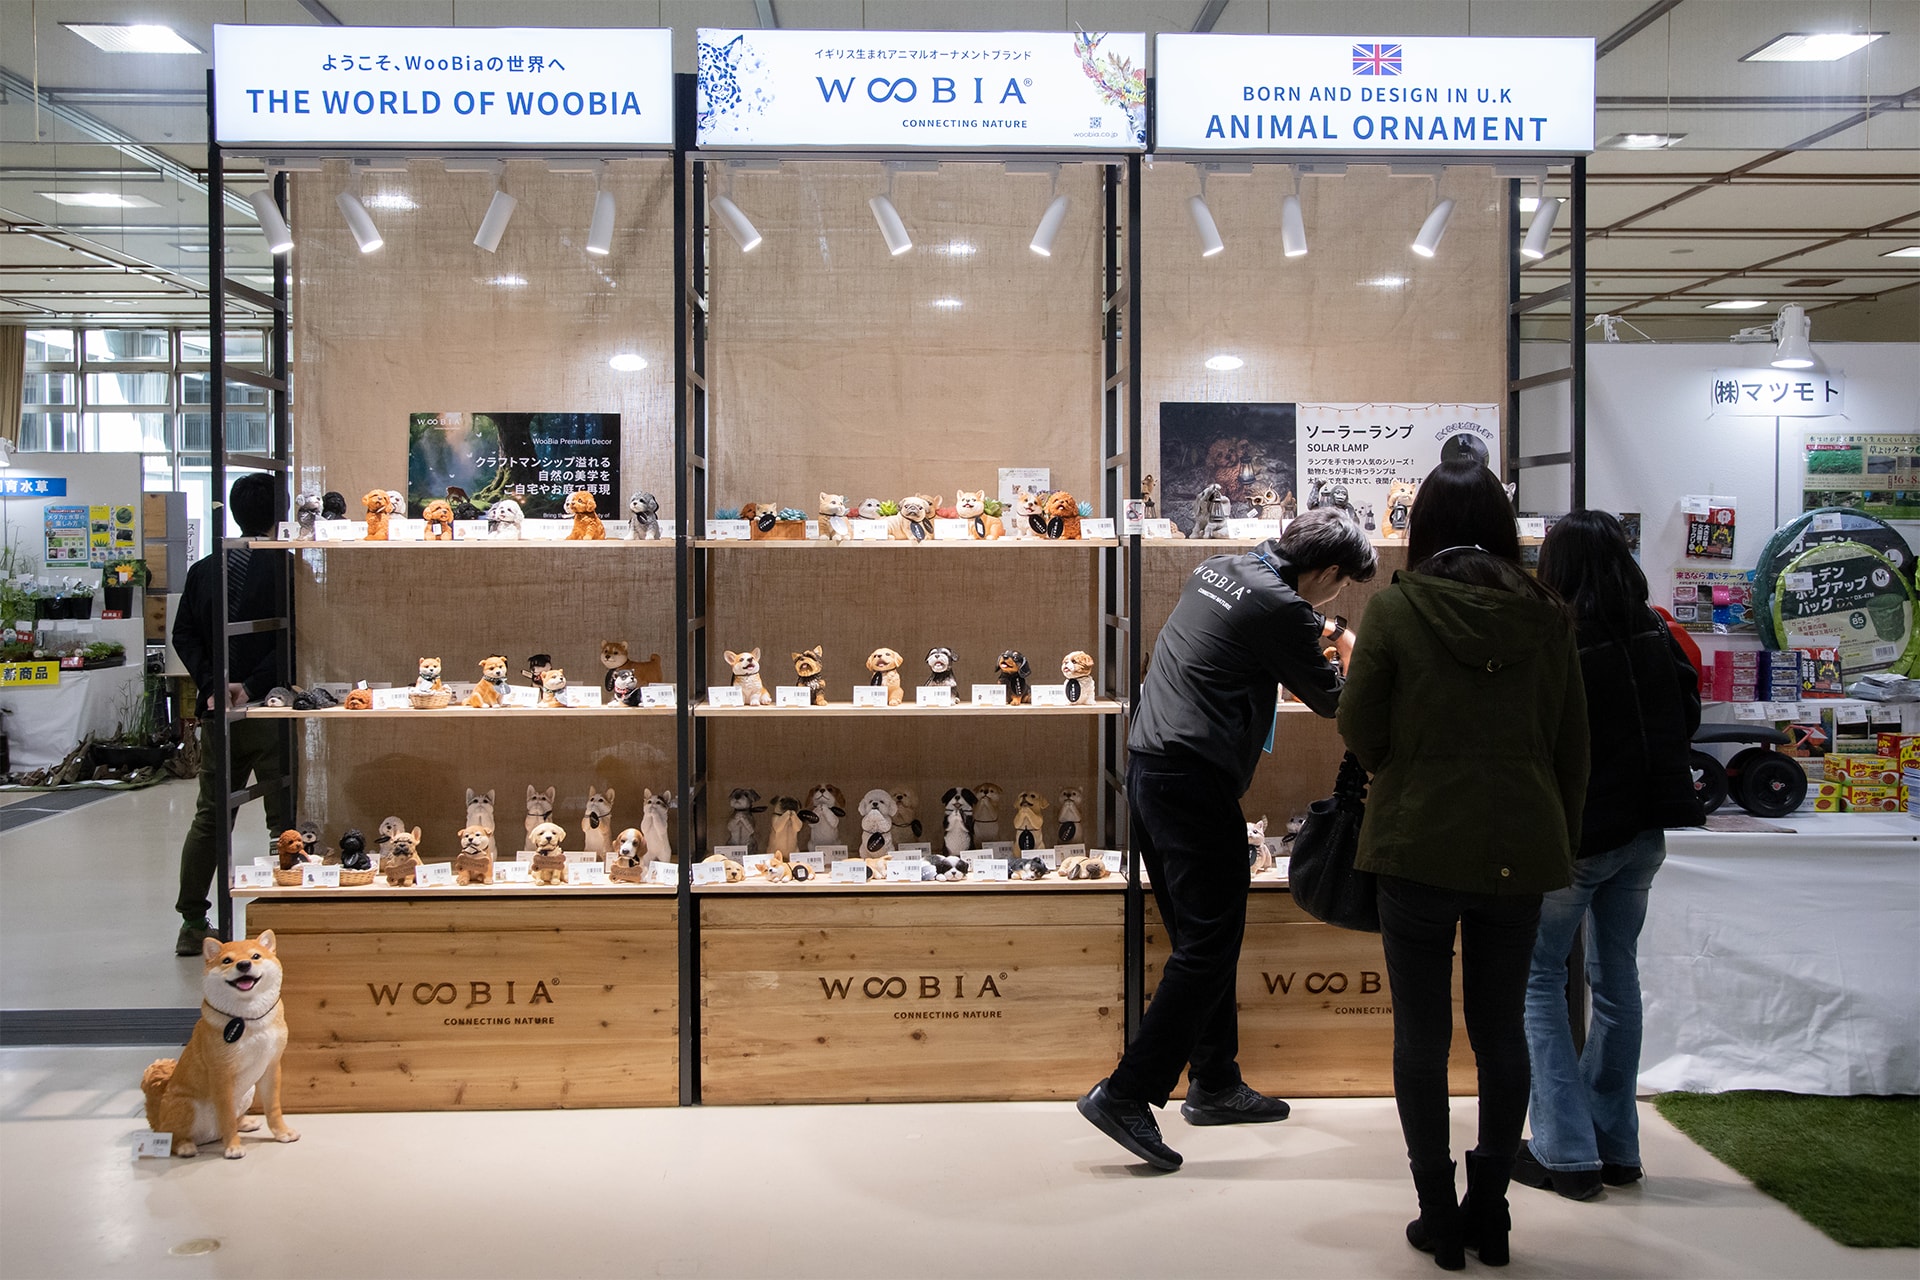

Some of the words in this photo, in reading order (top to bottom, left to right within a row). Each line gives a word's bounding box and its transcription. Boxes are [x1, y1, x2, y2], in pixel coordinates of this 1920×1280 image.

[814, 48, 1032, 61] イギリス生まれアニマルオーナメントブランド
[321, 54, 566, 73] ようこそ、WooBiaの世界へ
[1242, 86, 1301, 101] BORN
[1309, 86, 1351, 102] AND
[1360, 87, 1438, 103] DESIGN
[1447, 87, 1468, 103] IN
[1477, 88, 1511, 104] U.K
[246, 89, 310, 114] THE
[322, 90, 441, 115] WORLD
[454, 91, 496, 115] OF
[507, 91, 642, 116] WOOBIA
[902, 119, 979, 129] CONNECTING
[982, 119, 1028, 129] NATURE
[1205, 114, 1338, 139] ANIMAL
[1352, 115, 1548, 142] ORNAMENT
[1306, 424, 1414, 439] ソーラーランプ
[532, 437, 559, 445] WooBia
[560, 437, 590, 445] Premium
[592, 437, 612, 445] Decor
[1307, 443, 1340, 452] SOLAR
[1342, 443, 1369, 452] LAMP
[475, 456, 611, 468] クラフトマンシップ溢れる
[538, 470, 610, 481] 自然の美学を
[0, 479, 49, 493] 育水草
[503, 484, 611, 496] ご自宅やお庭で再現
[1875, 571, 1886, 582] M
[1798, 597, 1834, 615] バッグ
[1851, 617, 1864, 625] 85
[3, 666, 48, 681] 新商品
[893, 1011, 960, 1019] CONNECTING
[963, 1010, 1003, 1019] NATURE
[1335, 1006, 1393, 1015] CONNECTIN
[444, 1017, 511, 1026] CONNECTING
[514, 1016, 555, 1025] NATURE
